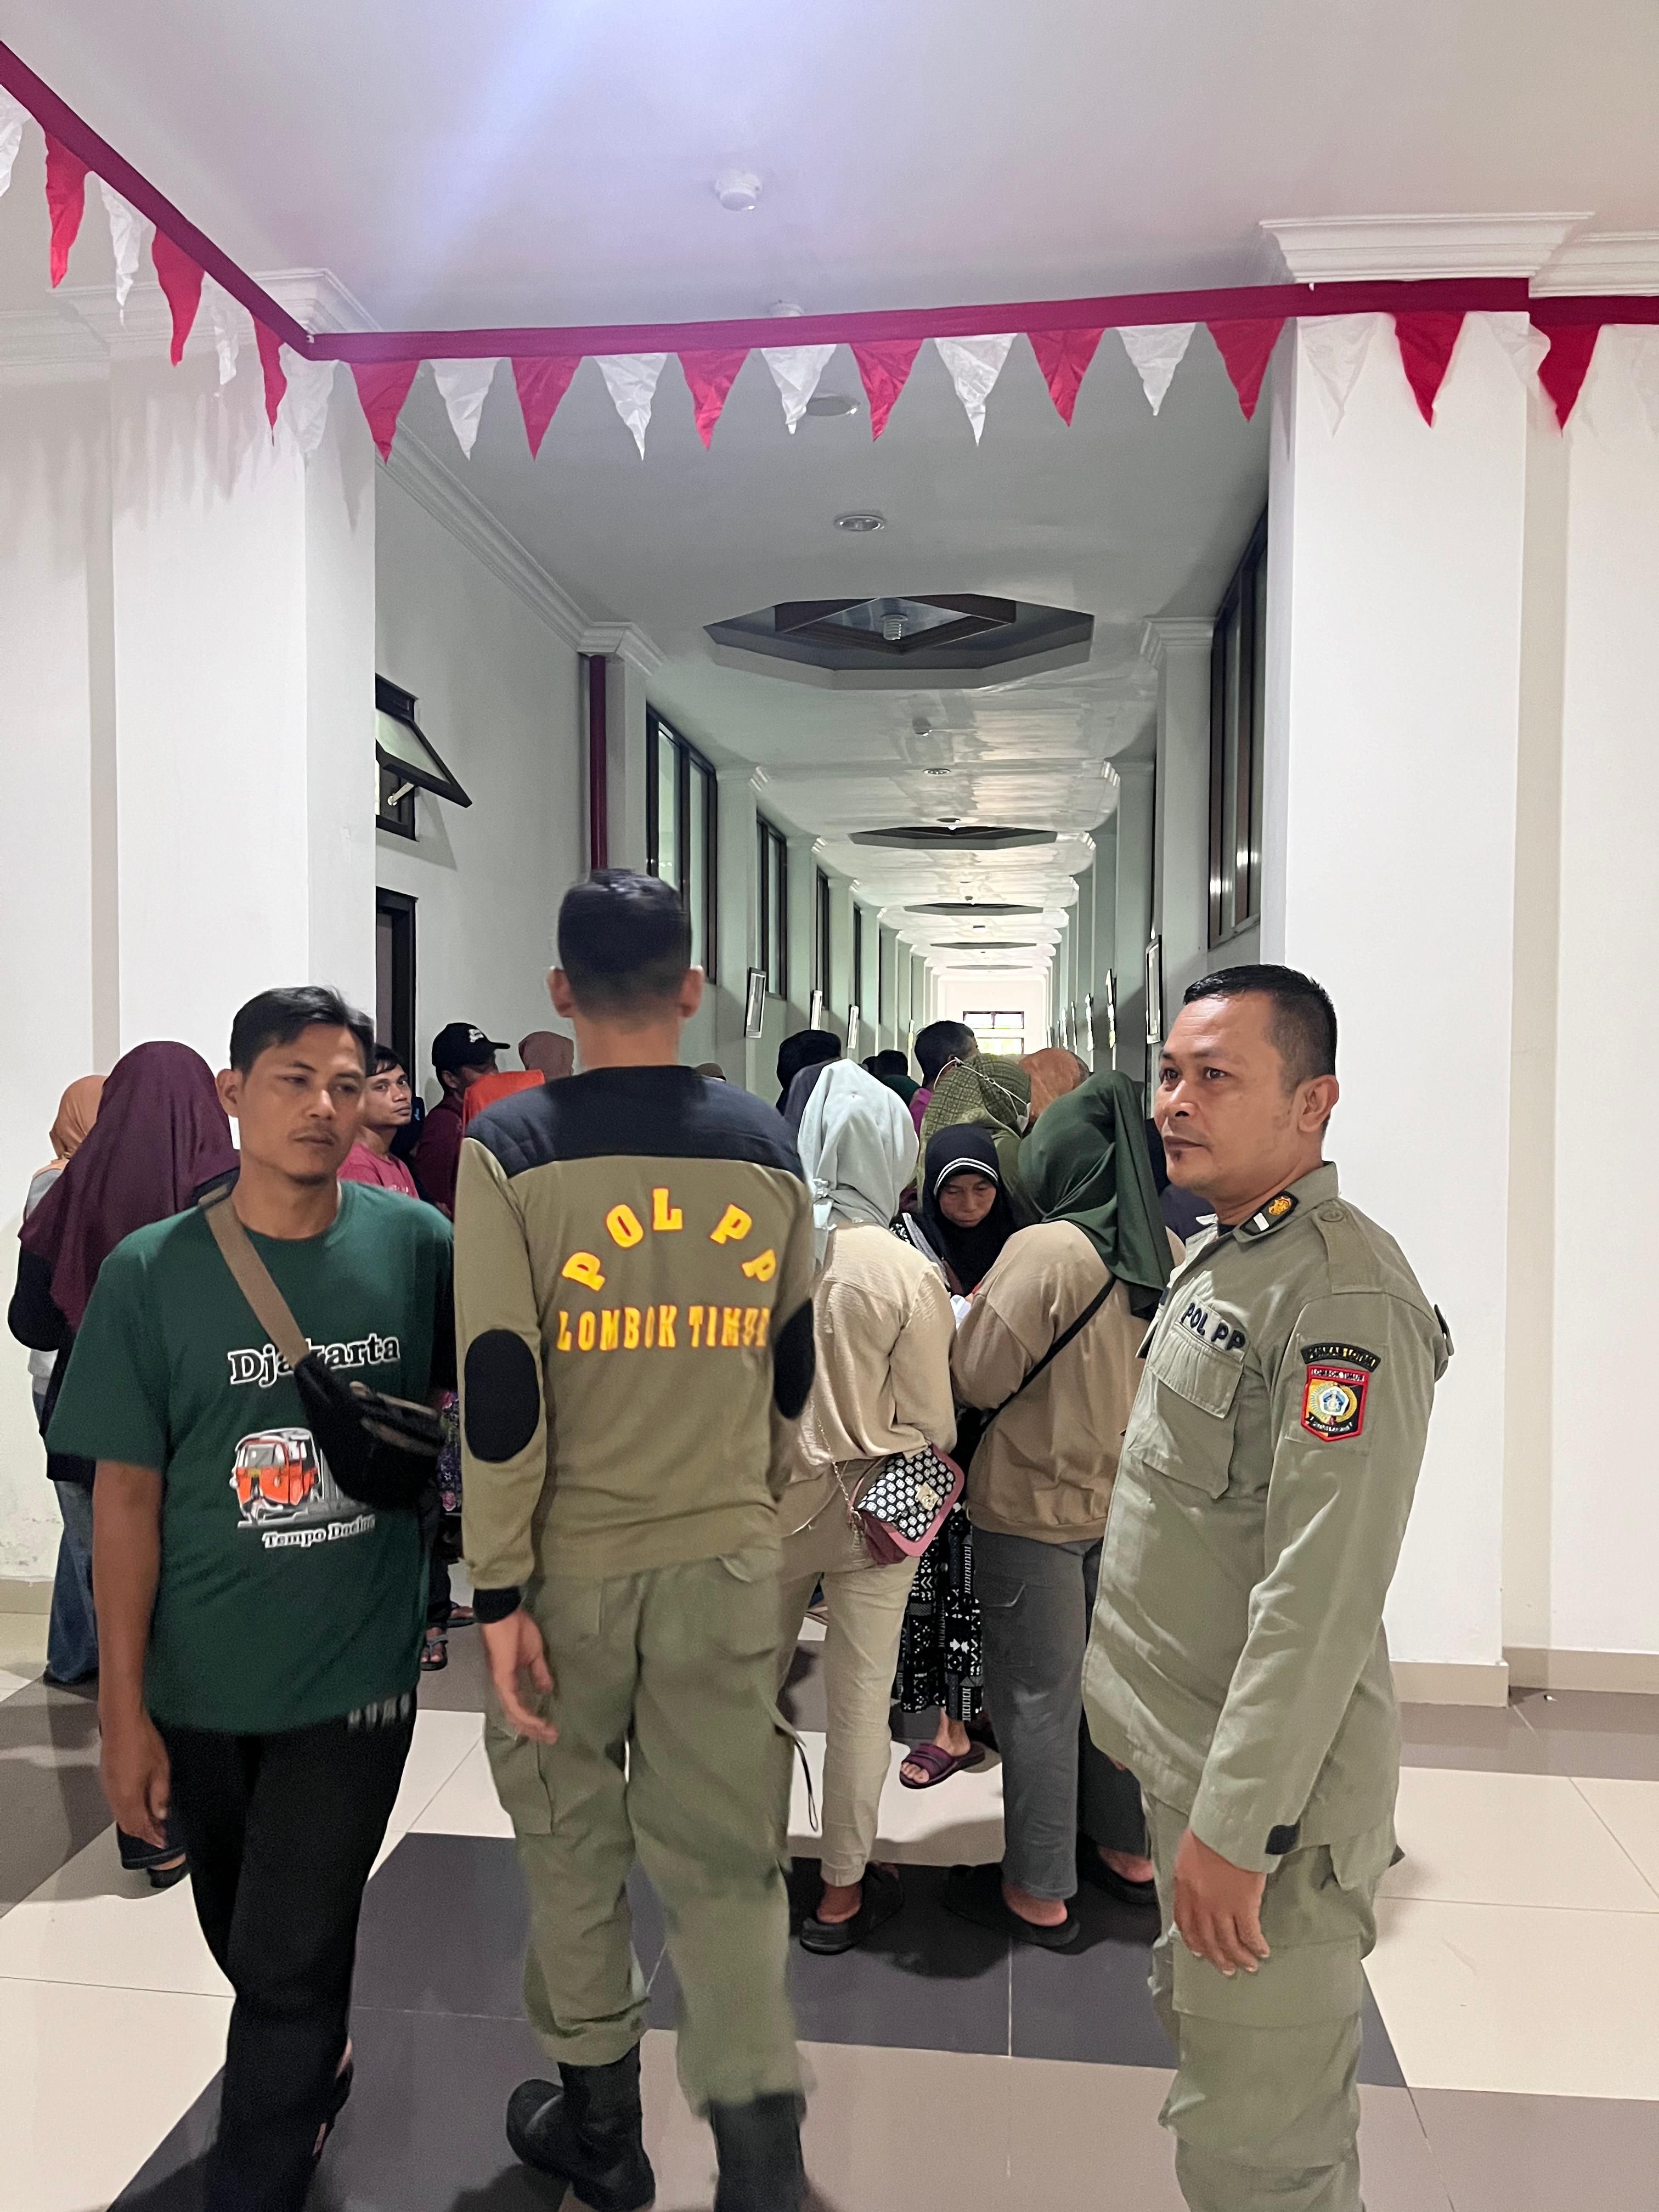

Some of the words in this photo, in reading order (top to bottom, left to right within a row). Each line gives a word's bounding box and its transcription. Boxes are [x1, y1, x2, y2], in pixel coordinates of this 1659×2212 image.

[561, 1187, 684, 1291] POL
[709, 1203, 777, 1283] PP
[1181, 1302, 1208, 1336] POL
[1211, 1322, 1246, 1351] PP
[262, 1528, 327, 1549] Tempo
